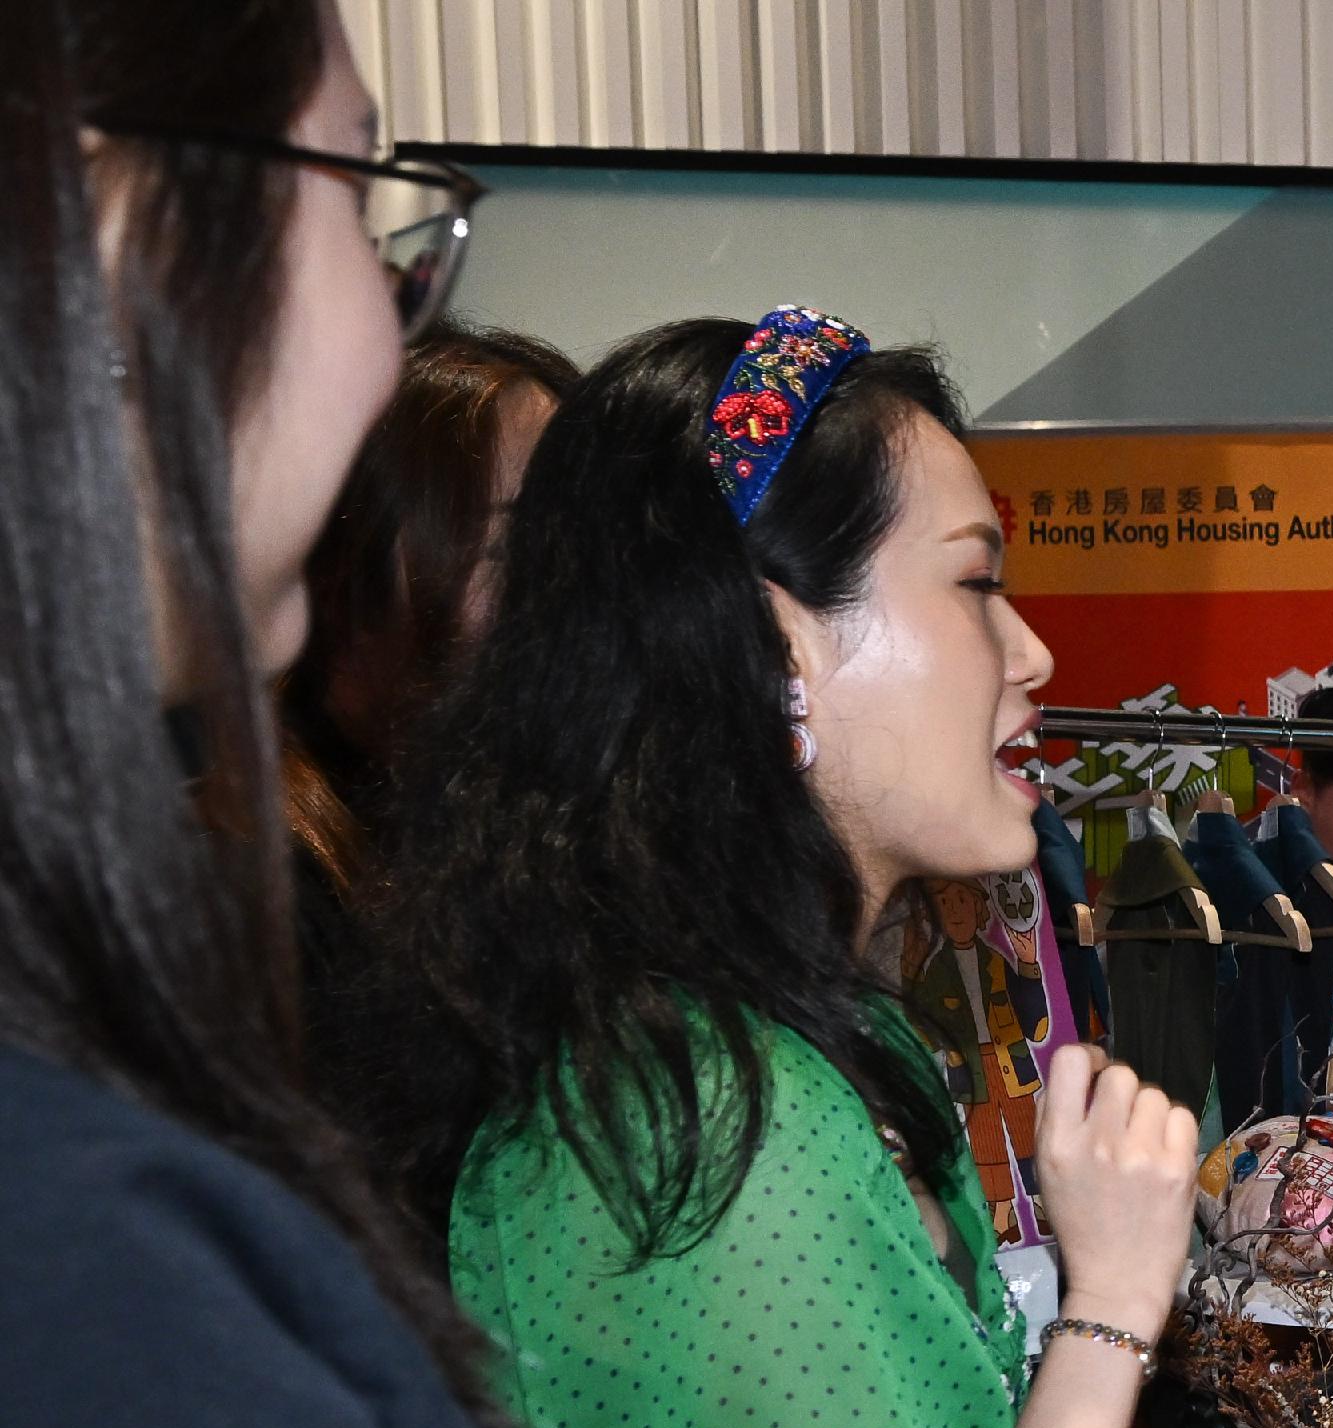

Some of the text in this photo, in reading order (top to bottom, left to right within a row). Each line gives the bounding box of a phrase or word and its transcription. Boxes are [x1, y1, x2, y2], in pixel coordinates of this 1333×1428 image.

[1030, 483, 1278, 517] 香港房屋委員會
[1029, 520, 1095, 549] Hong
[1103, 520, 1169, 549] Kong
[1177, 517, 1279, 547] Housing
